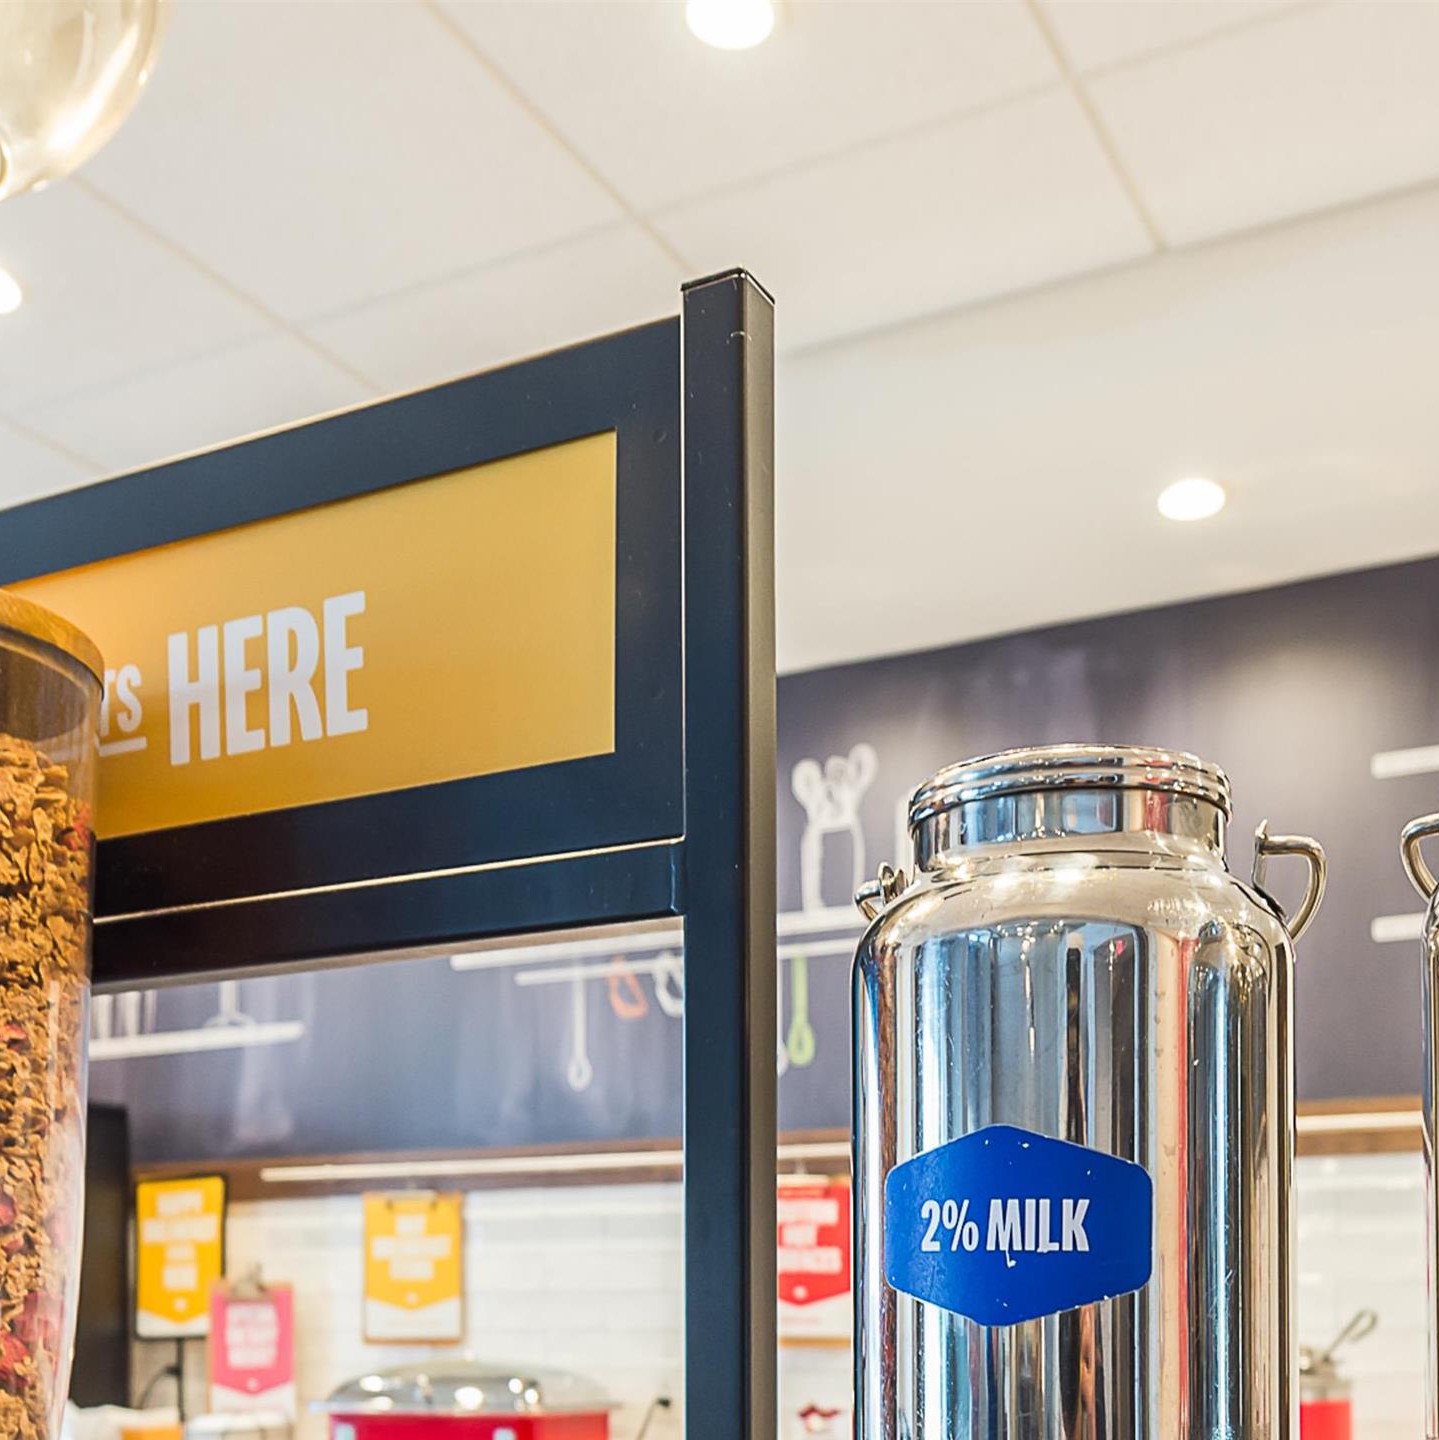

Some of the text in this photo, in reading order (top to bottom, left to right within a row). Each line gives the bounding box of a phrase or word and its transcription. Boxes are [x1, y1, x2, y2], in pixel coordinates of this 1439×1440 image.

[166, 590, 369, 767] HERE
[920, 1198, 1090, 1253] 2% MILK
